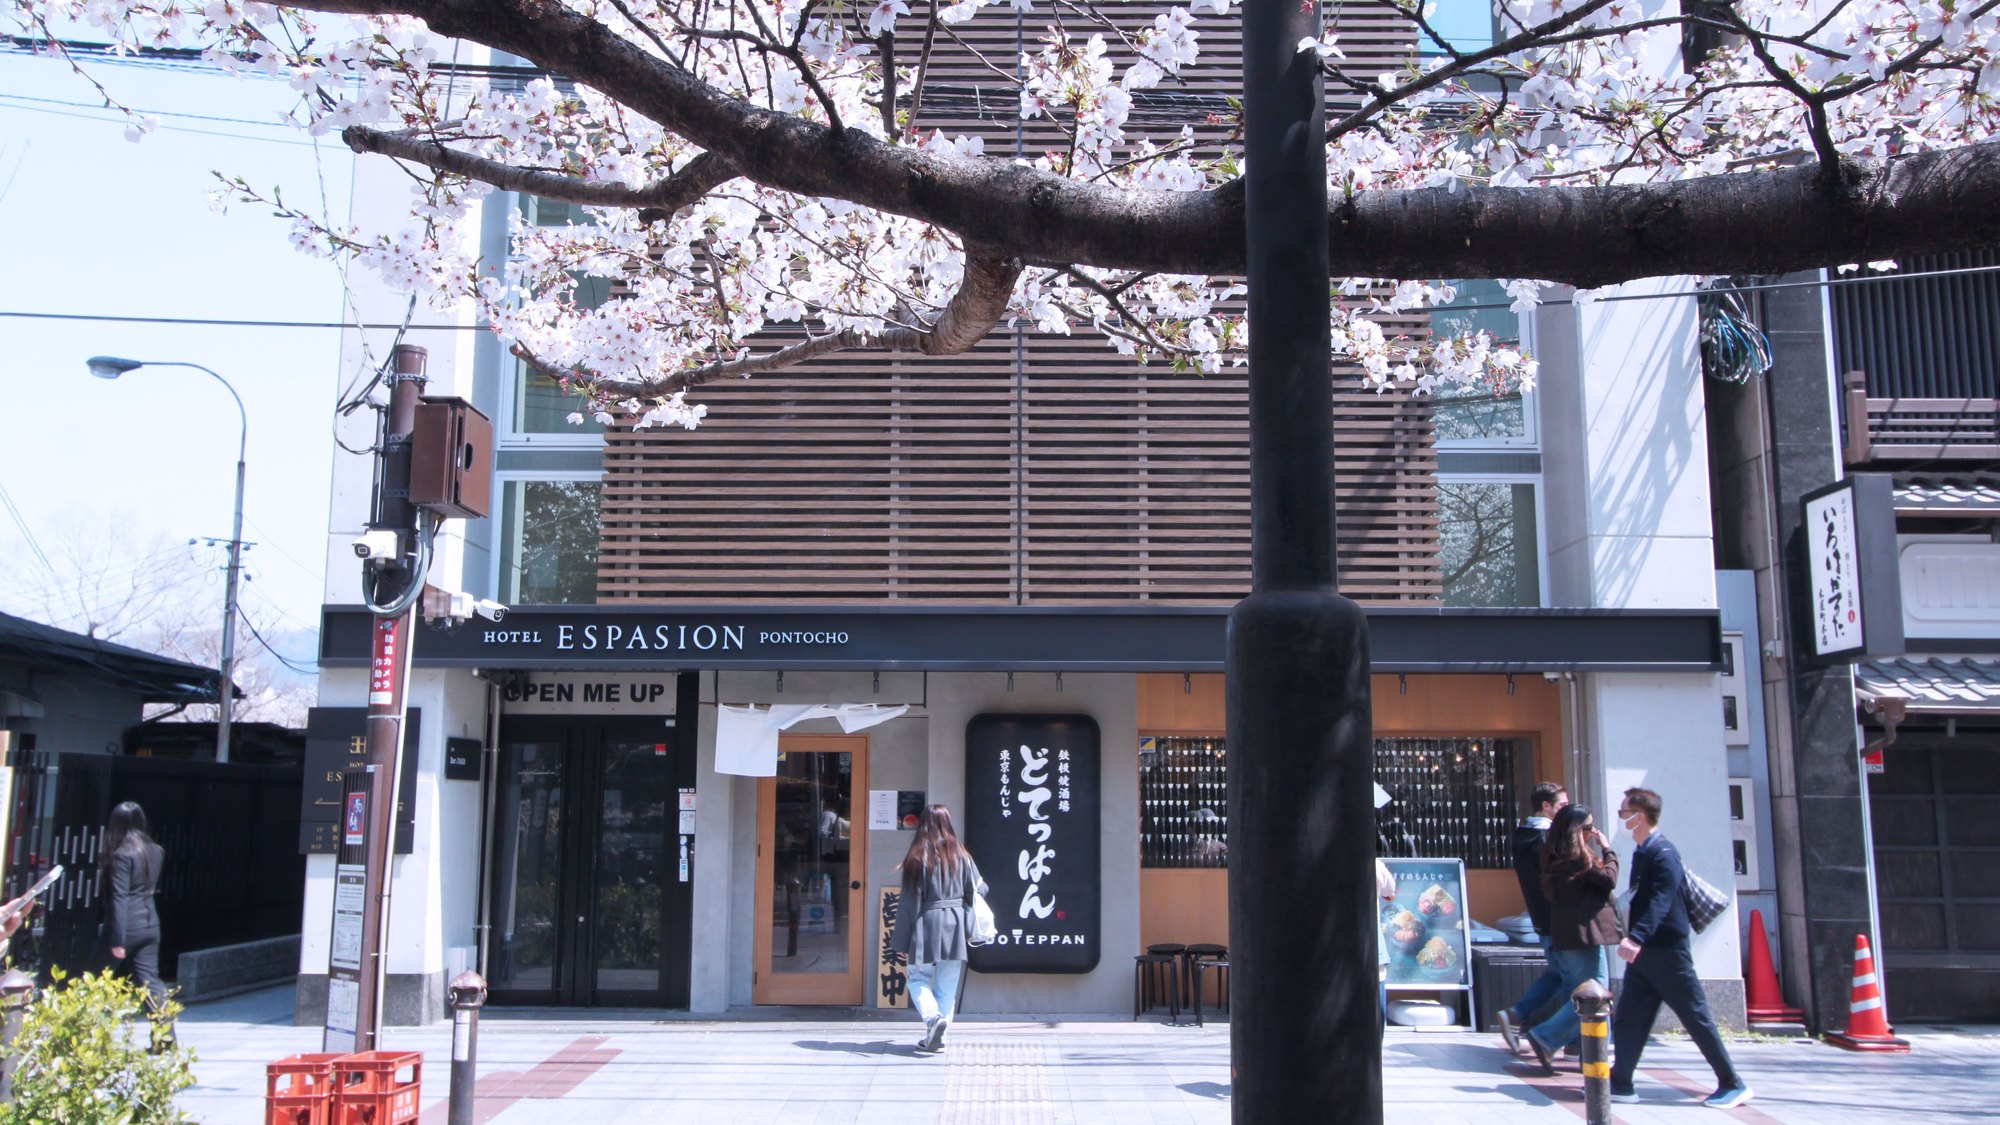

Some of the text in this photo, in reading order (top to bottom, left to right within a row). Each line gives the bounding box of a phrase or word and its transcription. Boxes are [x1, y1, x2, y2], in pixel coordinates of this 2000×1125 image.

[1823, 507, 1845, 638] いろはかるた
[382, 634, 394, 689] 防犯カメラ
[483, 625, 849, 650] HOTEL ESPASION PONTOCHO
[373, 657, 383, 690] 作動中
[583, 683, 620, 702] ME
[630, 683, 665, 702] UP
[1000, 749, 1012, 818] 東京もんじゃ
[1058, 749, 1070, 813] 鉄板焼酒場
[1018, 745, 1056, 919] どてっぱん
[1394, 872, 1444, 881] すすめもんじゃ
